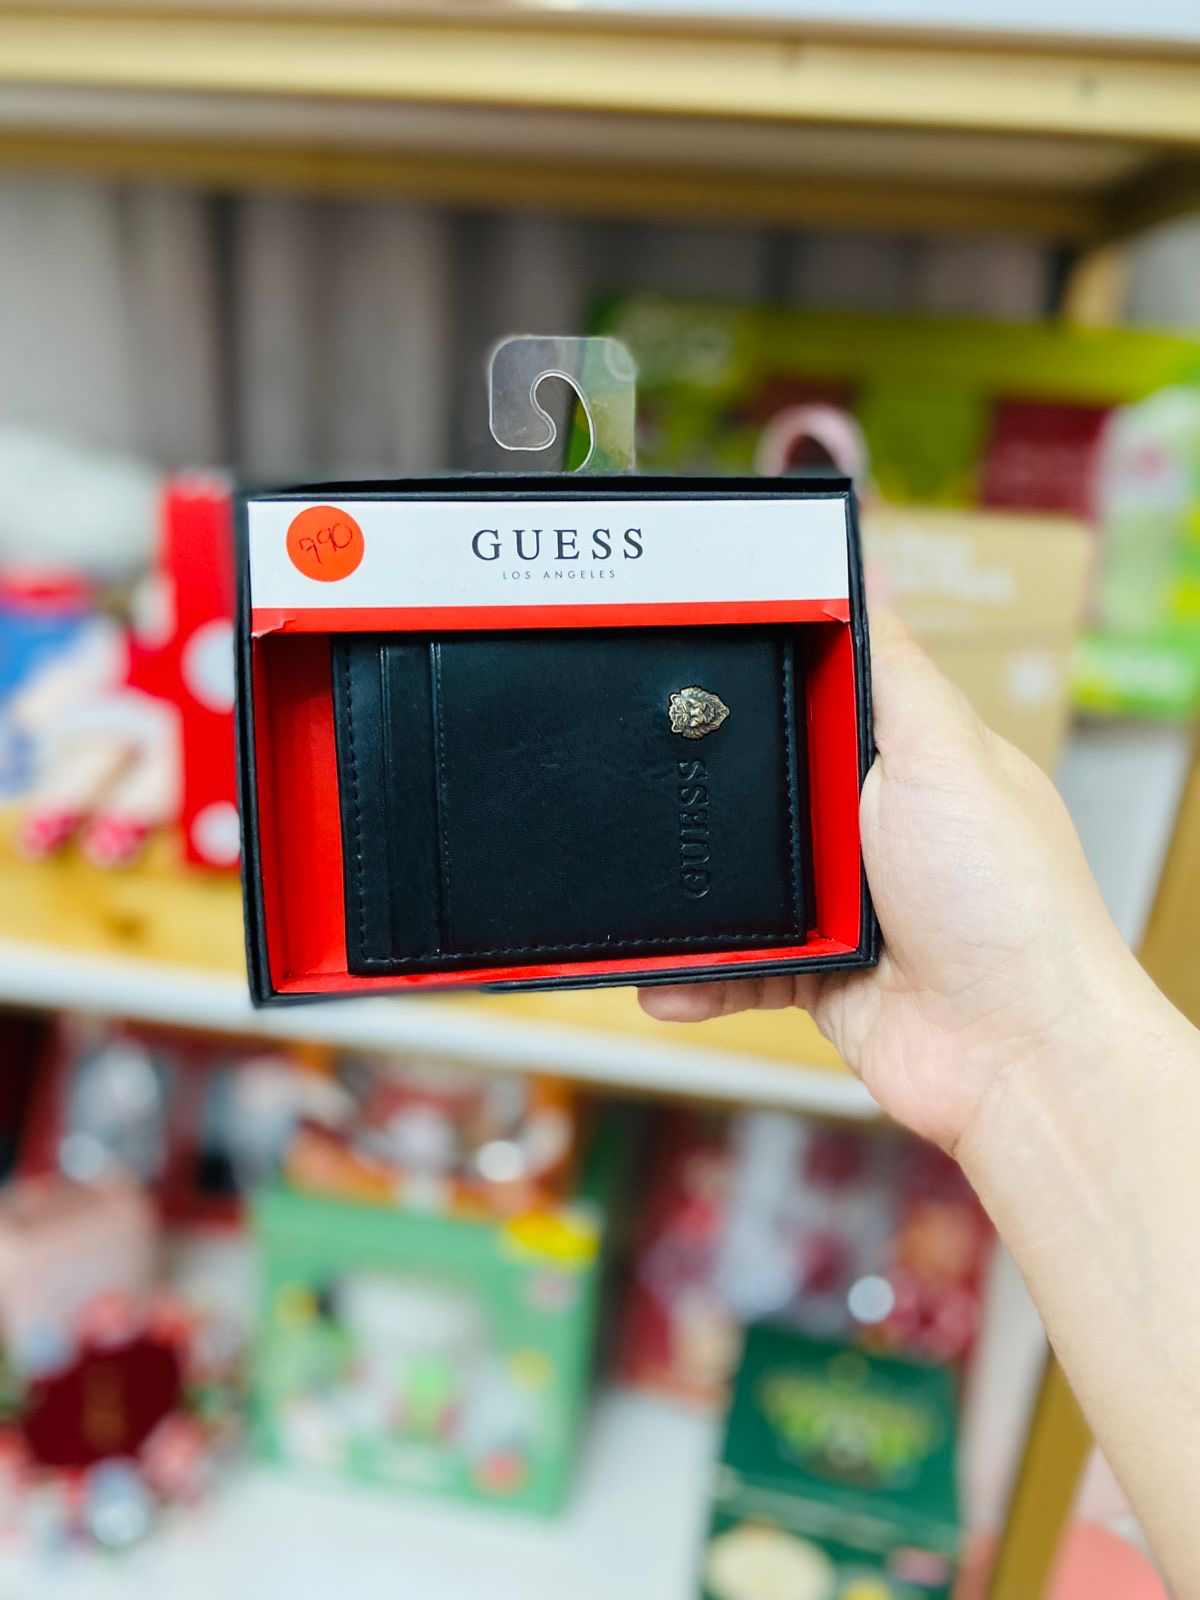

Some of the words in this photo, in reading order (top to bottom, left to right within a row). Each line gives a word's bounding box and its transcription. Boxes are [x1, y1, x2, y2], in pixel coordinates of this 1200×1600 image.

[471, 528, 644, 561] GUESS
[502, 570, 532, 580] LOS
[543, 569, 616, 580] ANGELES
[679, 759, 711, 899] GUESS
